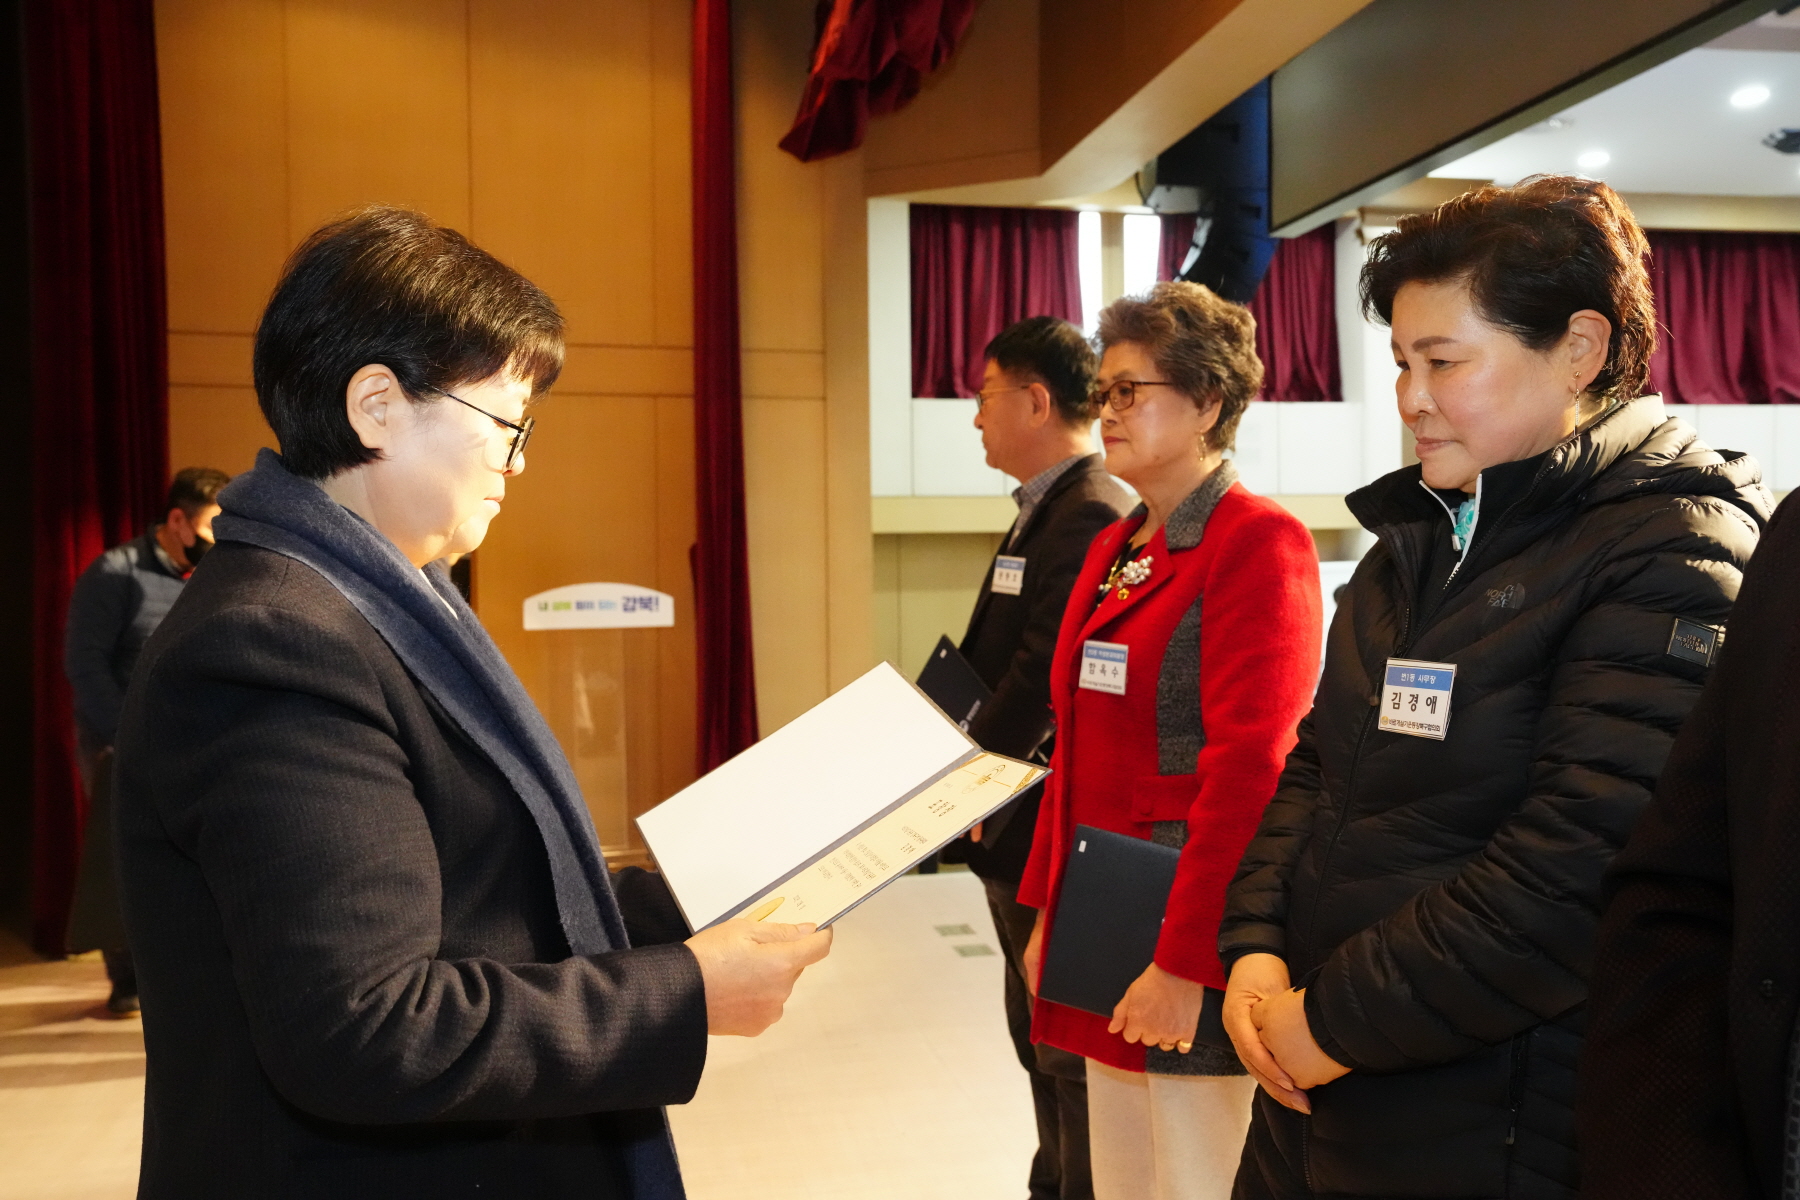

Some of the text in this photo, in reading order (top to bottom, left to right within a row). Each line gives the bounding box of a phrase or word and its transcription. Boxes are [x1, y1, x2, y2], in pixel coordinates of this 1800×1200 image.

[1484, 588, 1514, 601] NORH
[1487, 598, 1510, 608] FAE
[1417, 674, 1436, 684] 사무장
[1391, 692, 1438, 714] 김경애
